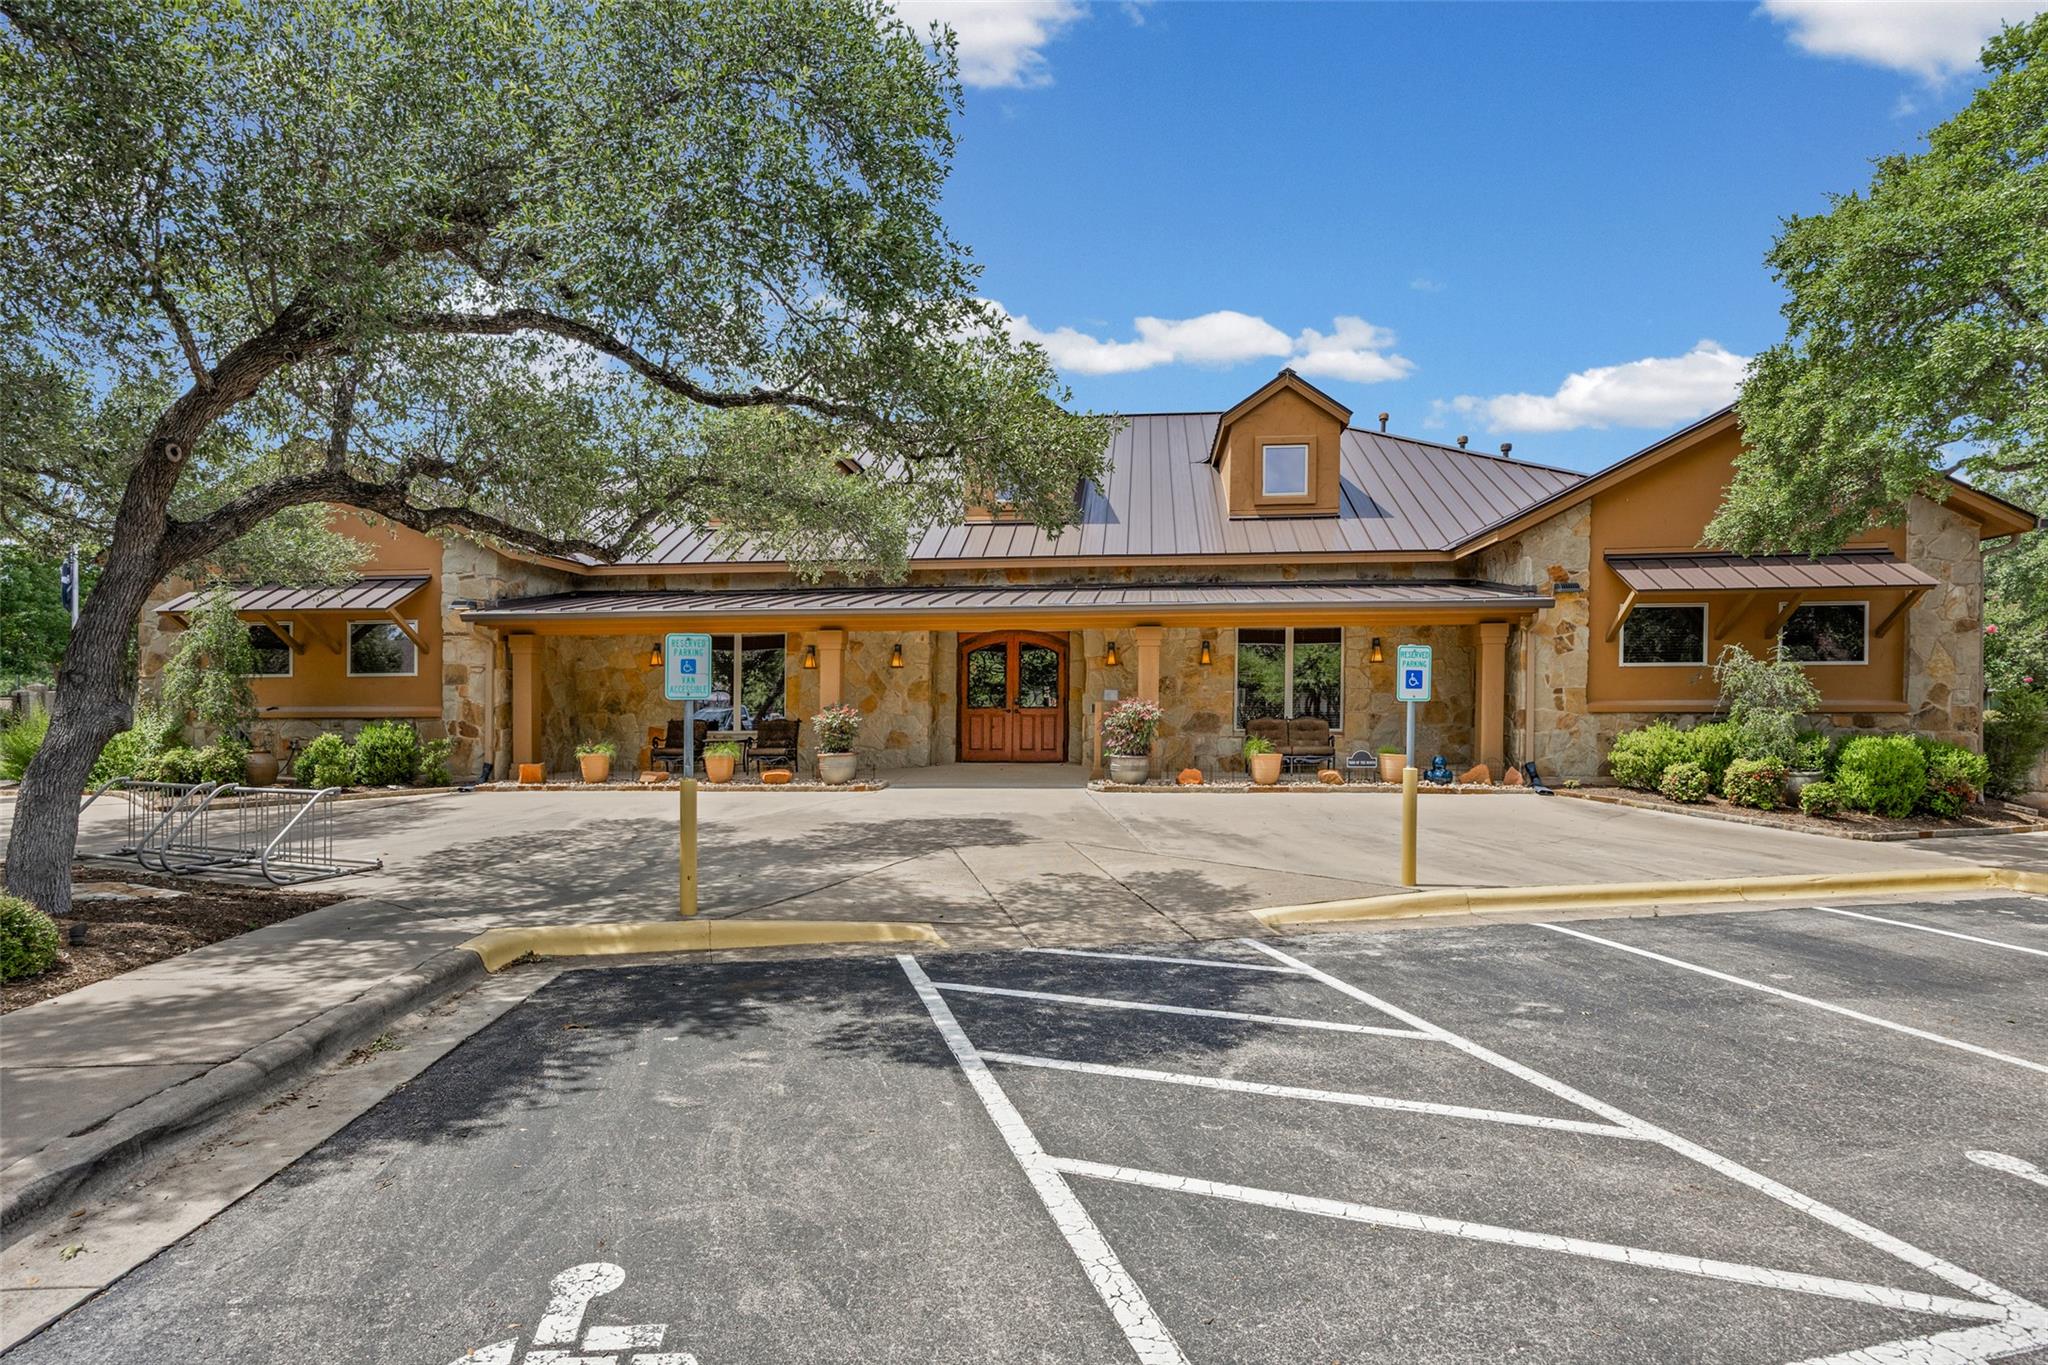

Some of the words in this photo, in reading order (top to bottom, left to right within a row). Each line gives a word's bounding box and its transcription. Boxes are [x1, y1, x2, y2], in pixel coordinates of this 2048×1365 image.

[672, 639, 705, 647] RESERVED
[673, 648, 704, 656] PARKING
[670, 685, 707, 693] ACCESSIBLE
